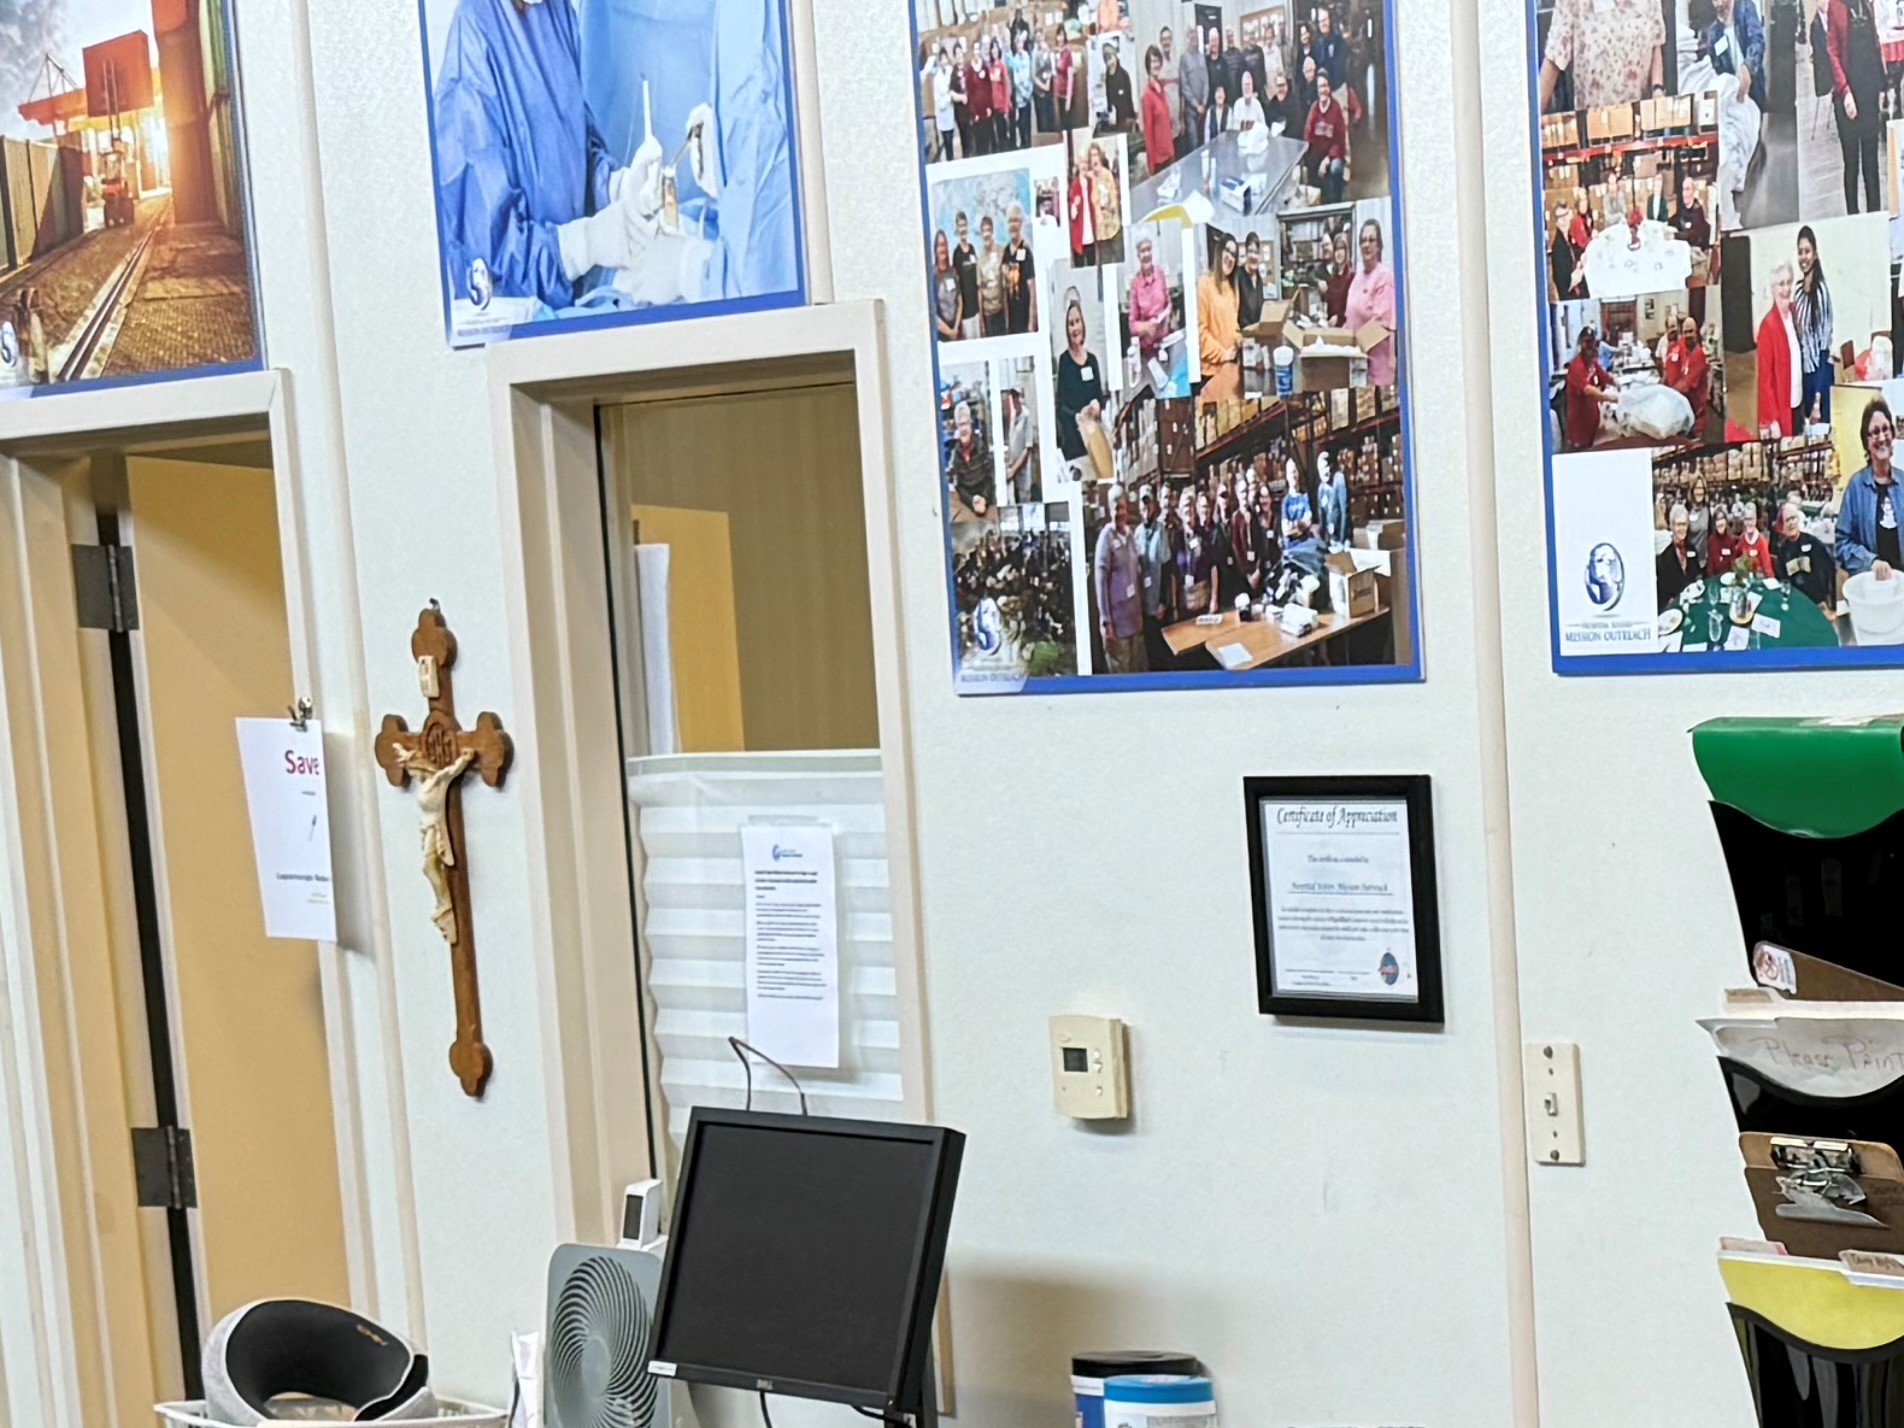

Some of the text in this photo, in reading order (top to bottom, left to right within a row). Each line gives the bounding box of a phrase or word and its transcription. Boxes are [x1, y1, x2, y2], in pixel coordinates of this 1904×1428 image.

[284, 749, 320, 775] Save
[1276, 805, 1398, 829] Certificate of Appreciation
